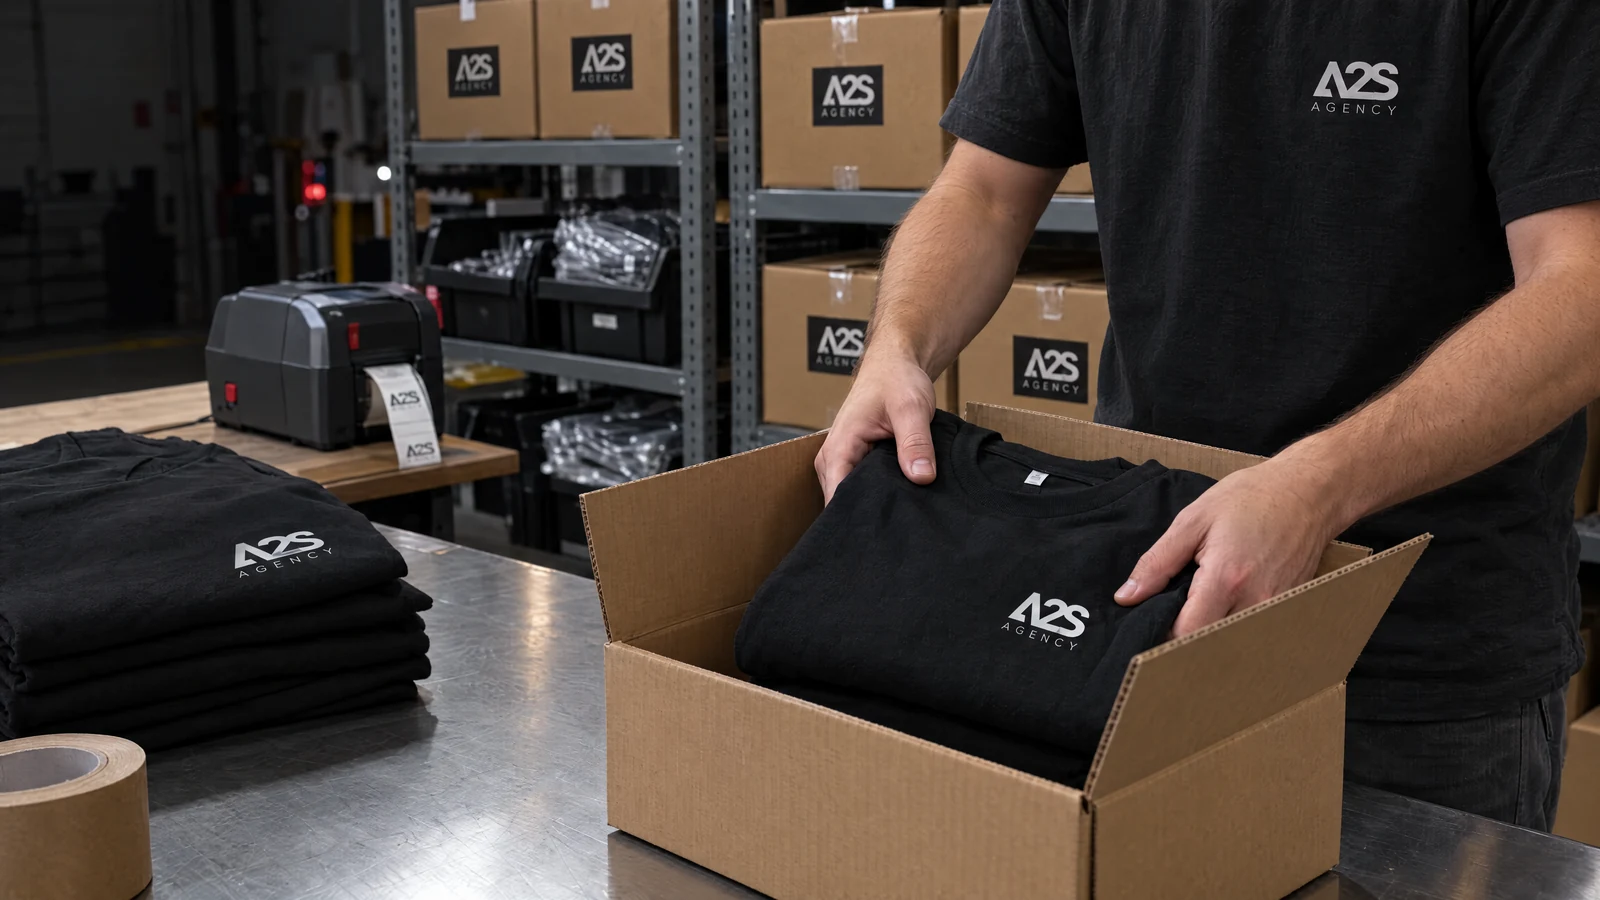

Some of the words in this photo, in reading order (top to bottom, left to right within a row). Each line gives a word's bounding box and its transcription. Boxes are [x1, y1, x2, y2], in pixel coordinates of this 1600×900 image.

[455, 53, 494, 82] A2S
[581, 42, 626, 74] A2S
[454, 81, 493, 91] AGENCY
[580, 74, 626, 84] AGENCY
[822, 74, 875, 106] A2S
[1312, 61, 1399, 101] A2S
[821, 107, 874, 118] AGENCY
[1310, 101, 1397, 116] AGENCY
[817, 325, 864, 357] A2S
[816, 355, 857, 367] AGENC
[1024, 347, 1079, 382] A2S
[390, 390, 420, 407] A2S
[1022, 379, 1079, 394] AGENCY
[407, 442, 435, 458] A2S
[235, 531, 324, 569] A2S
[239, 547, 332, 578] AGENCY
[1008, 592, 1090, 638] A2S
[1001, 622, 1078, 651] AGENCY
